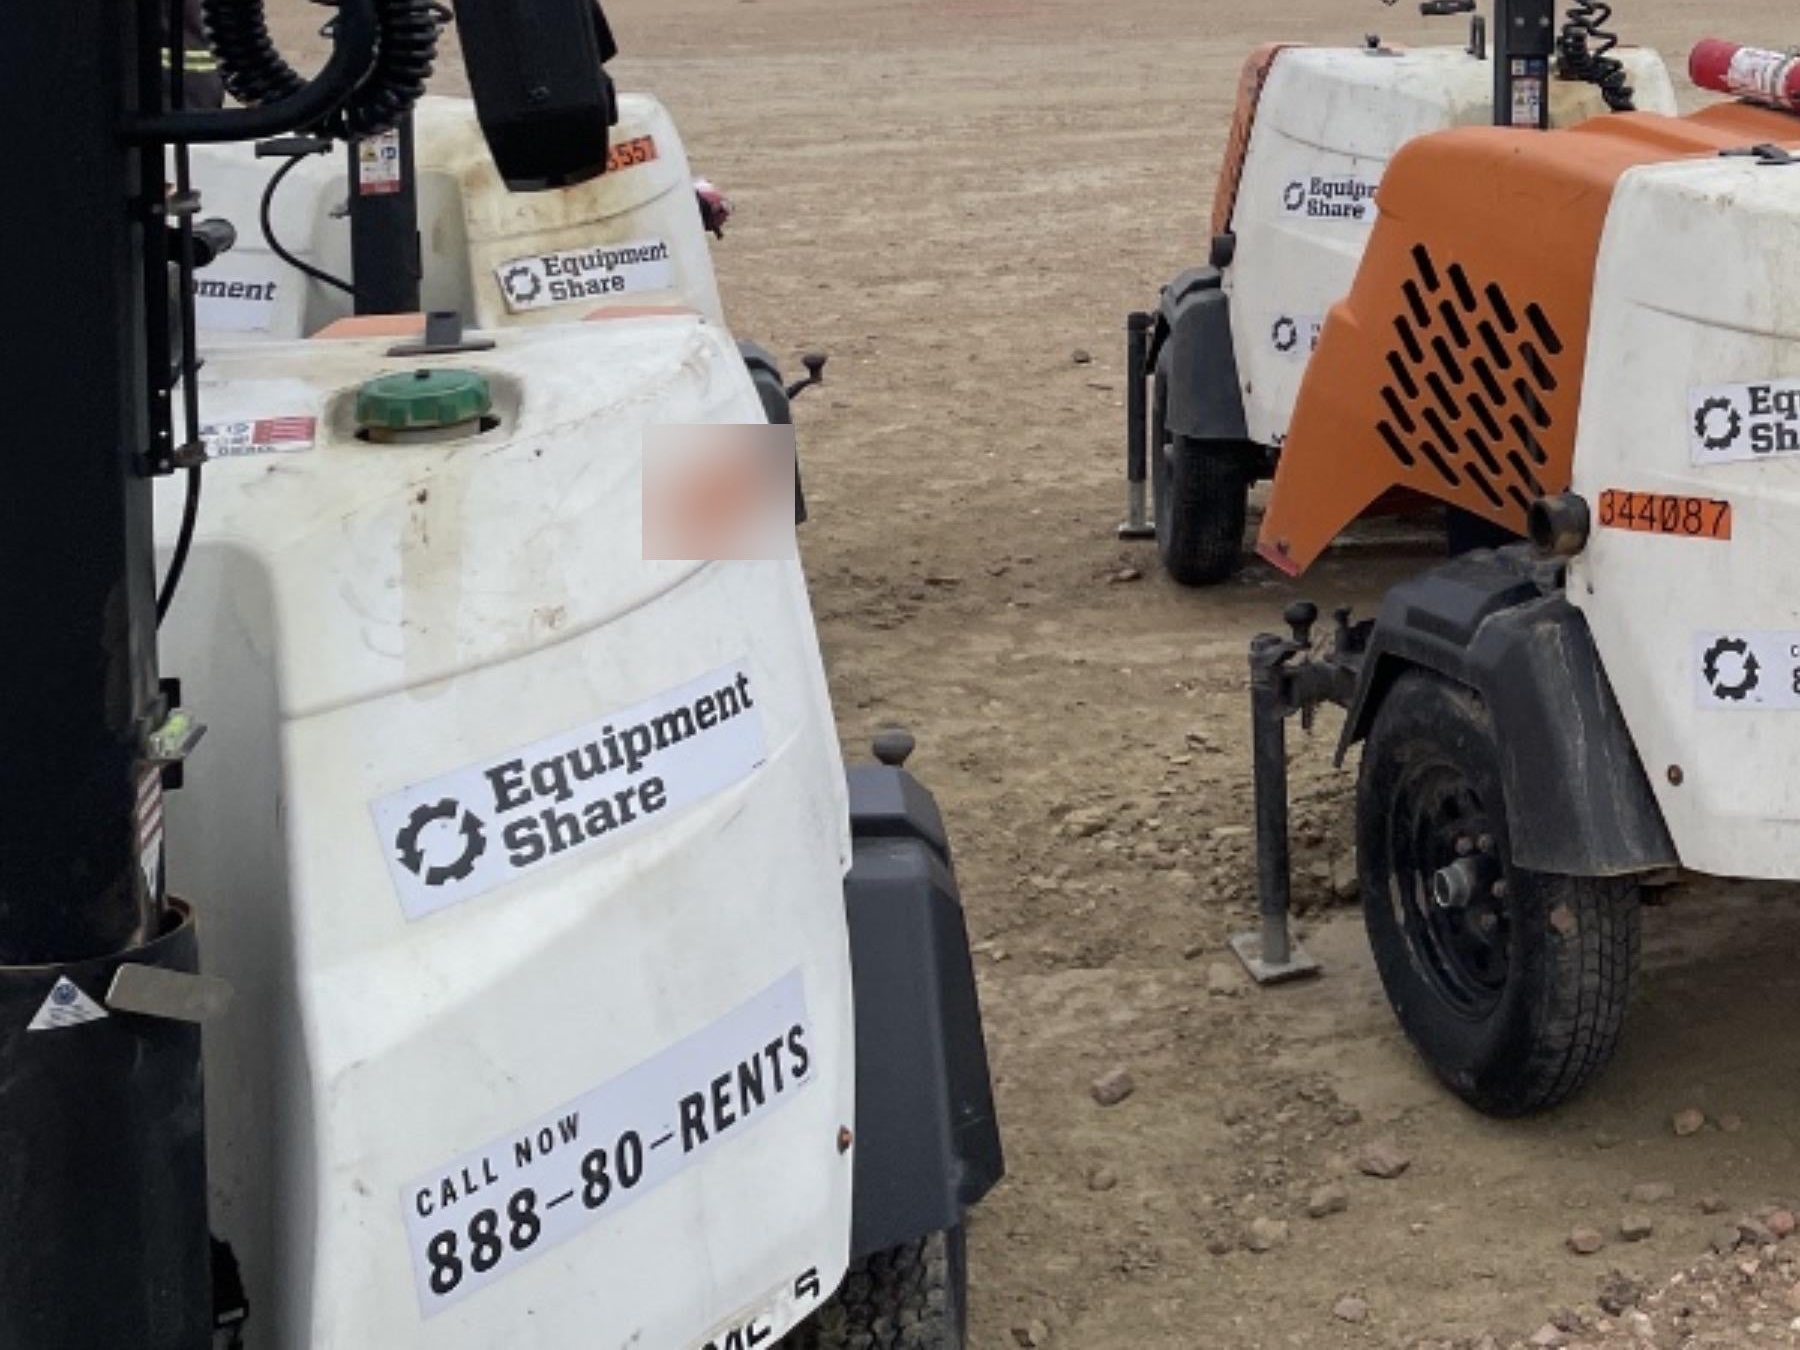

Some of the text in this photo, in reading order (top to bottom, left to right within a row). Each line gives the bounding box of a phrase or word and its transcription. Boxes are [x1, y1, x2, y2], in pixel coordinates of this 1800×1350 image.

[1307, 197, 1366, 219] Share
[541, 242, 669, 277] Equipment
[548, 274, 626, 301] Share
[1600, 488, 1730, 537] 344087
[483, 671, 754, 814] Equipment
[502, 775, 668, 868] Share
[416, 1111, 580, 1217] CALL NOW
[427, 1024, 811, 1295] 888-80-RENTS
